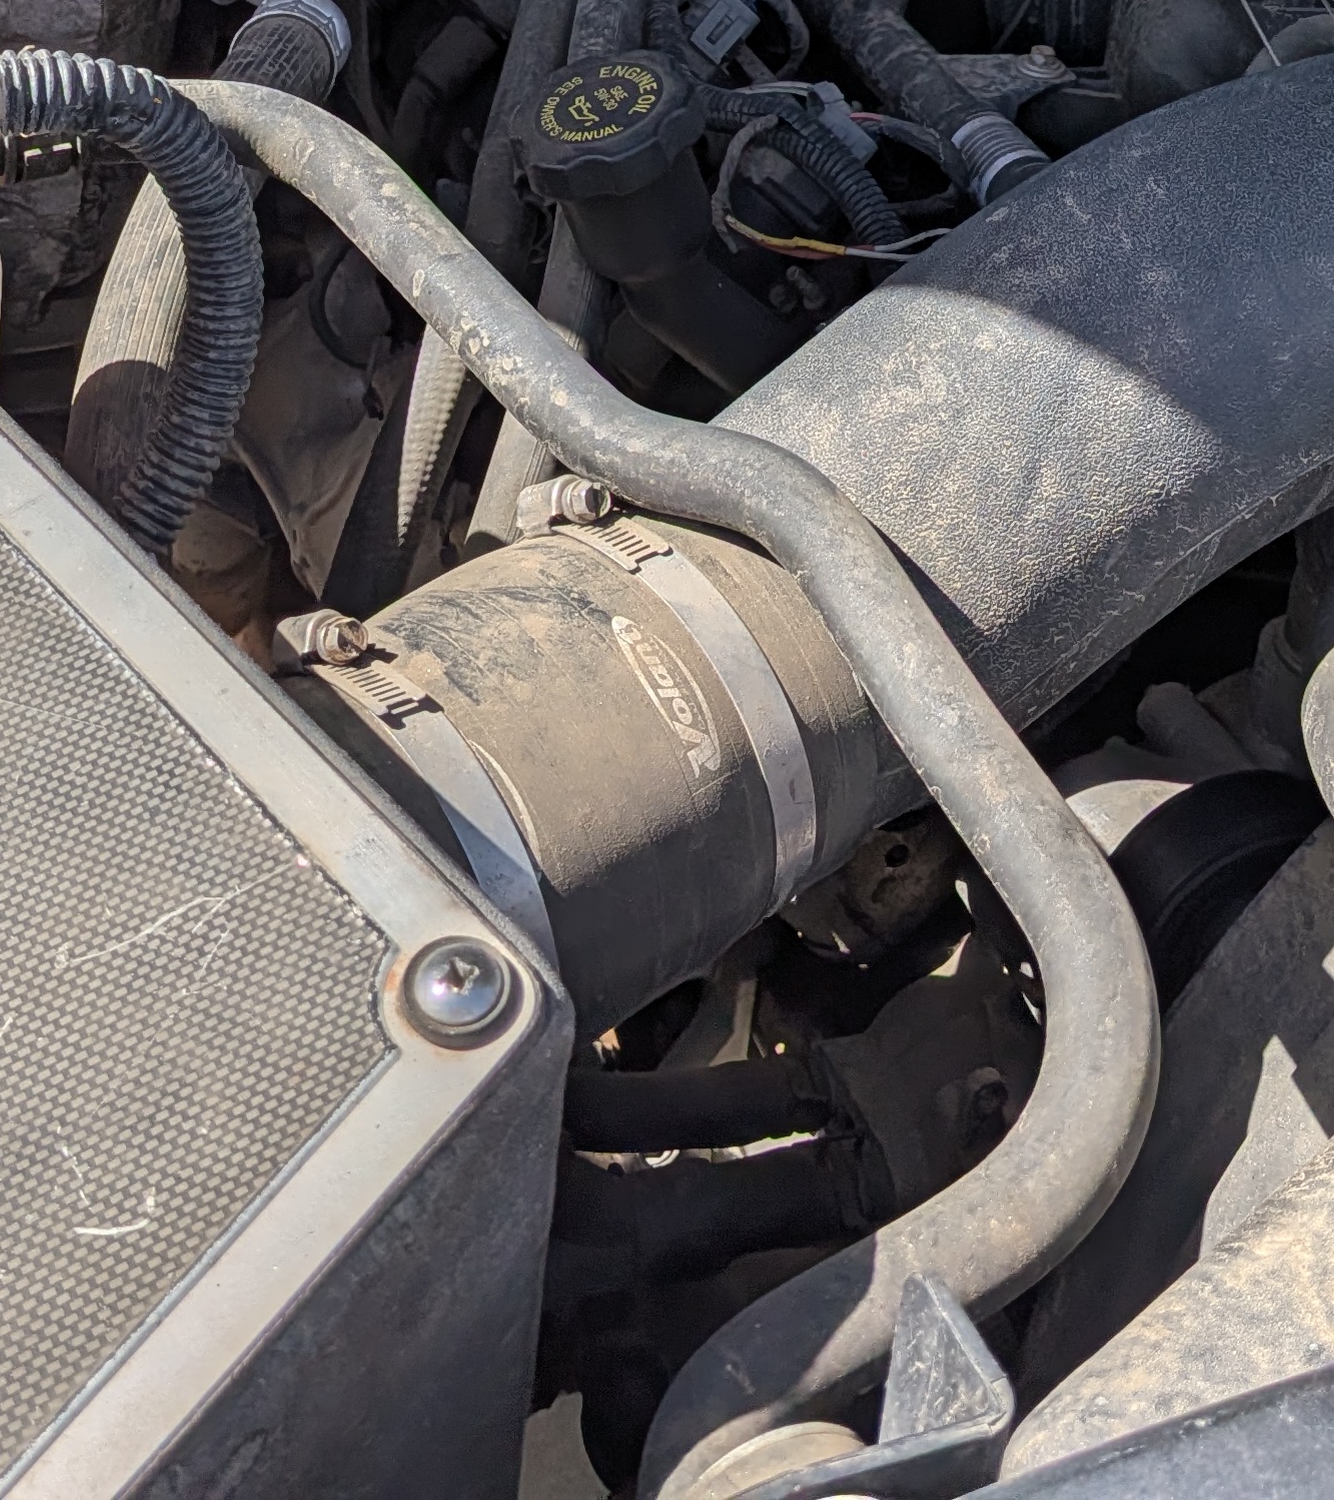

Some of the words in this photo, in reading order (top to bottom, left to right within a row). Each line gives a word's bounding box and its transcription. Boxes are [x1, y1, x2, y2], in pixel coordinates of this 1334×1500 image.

[554, 76, 583, 96] SEE
[599, 65, 658, 94] ENGINE
[594, 88, 618, 111] 5W-30
[610, 85, 628, 102] SAE
[628, 94, 656, 115] OIL
[540, 96, 563, 137] OWNER'S
[560, 123, 624, 142] MANUAL
[618, 623, 717, 779] Volant
